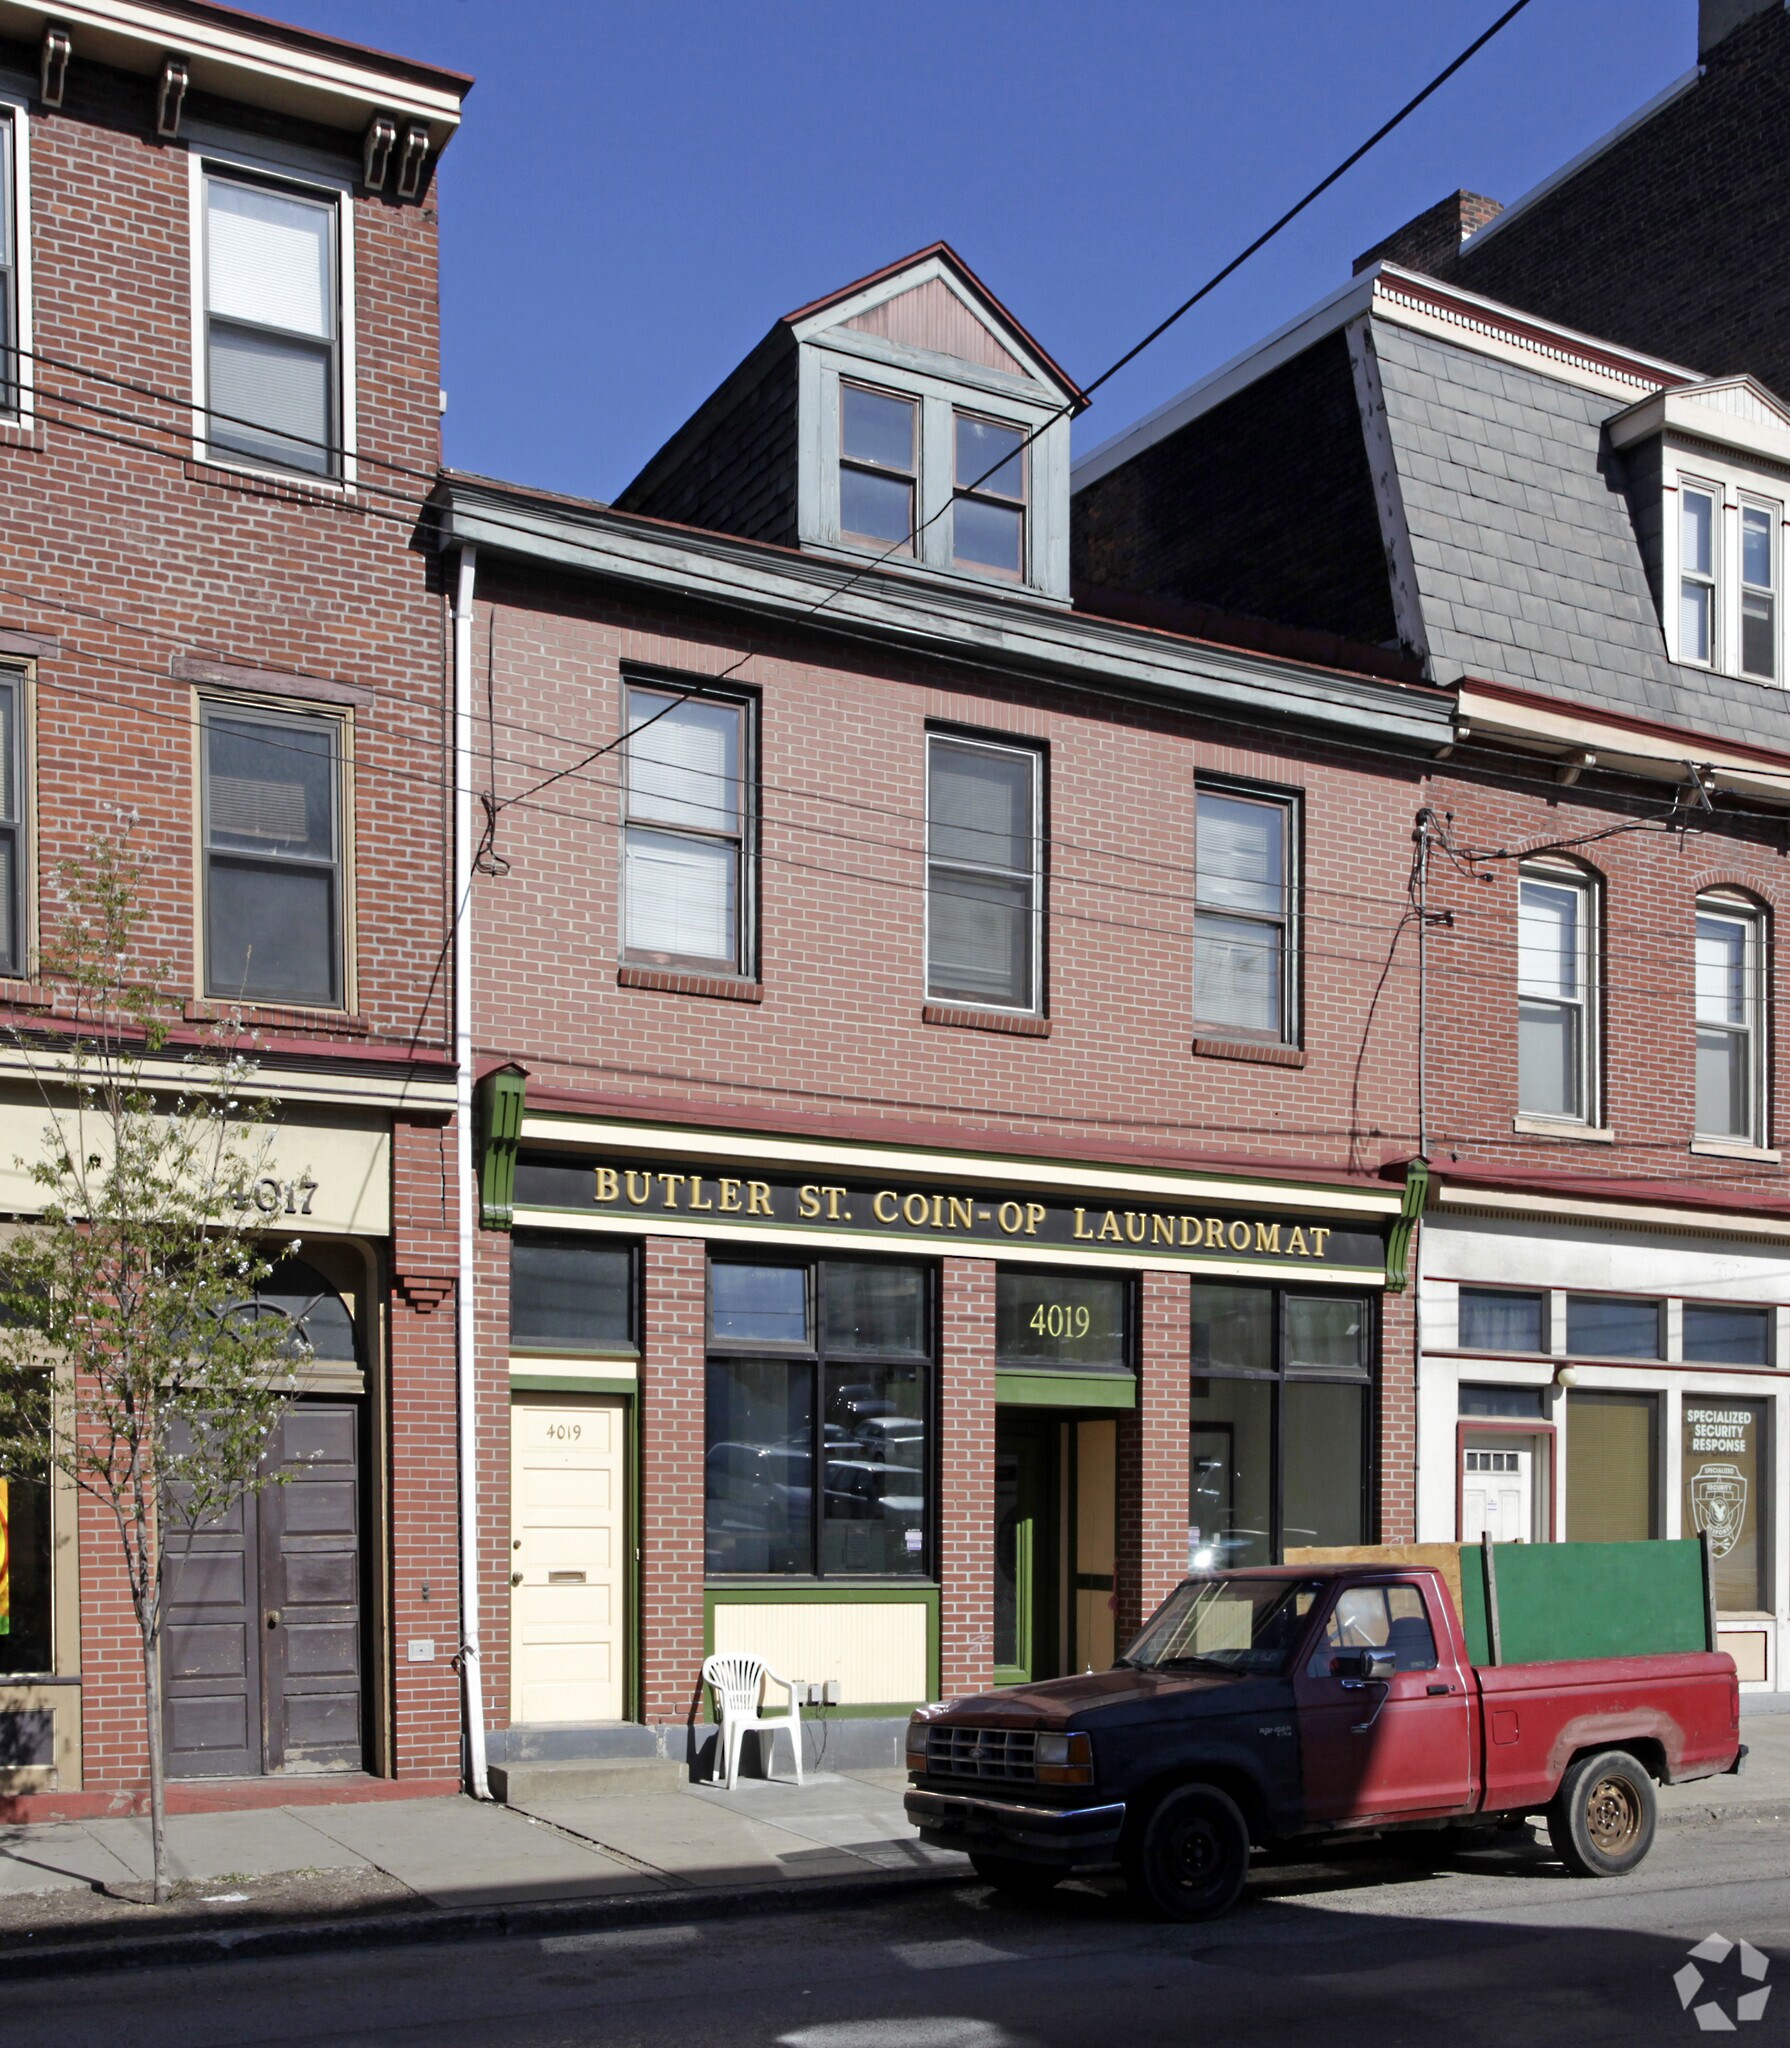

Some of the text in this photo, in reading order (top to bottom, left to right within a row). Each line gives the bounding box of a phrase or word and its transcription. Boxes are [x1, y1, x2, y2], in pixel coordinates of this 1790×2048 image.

[223, 1177, 319, 1215] 4017
[593, 1167, 1331, 1259] BUTLER ST. COIN-OP LAUNDROMAT
[1029, 1303, 1091, 1339] 4019
[1687, 1409, 1752, 1424] SPECIALIZED
[546, 1423, 582, 1441] 4019
[1694, 1424, 1744, 1438] SECURITY
[1692, 1439, 1746, 1452] RESPONSE
